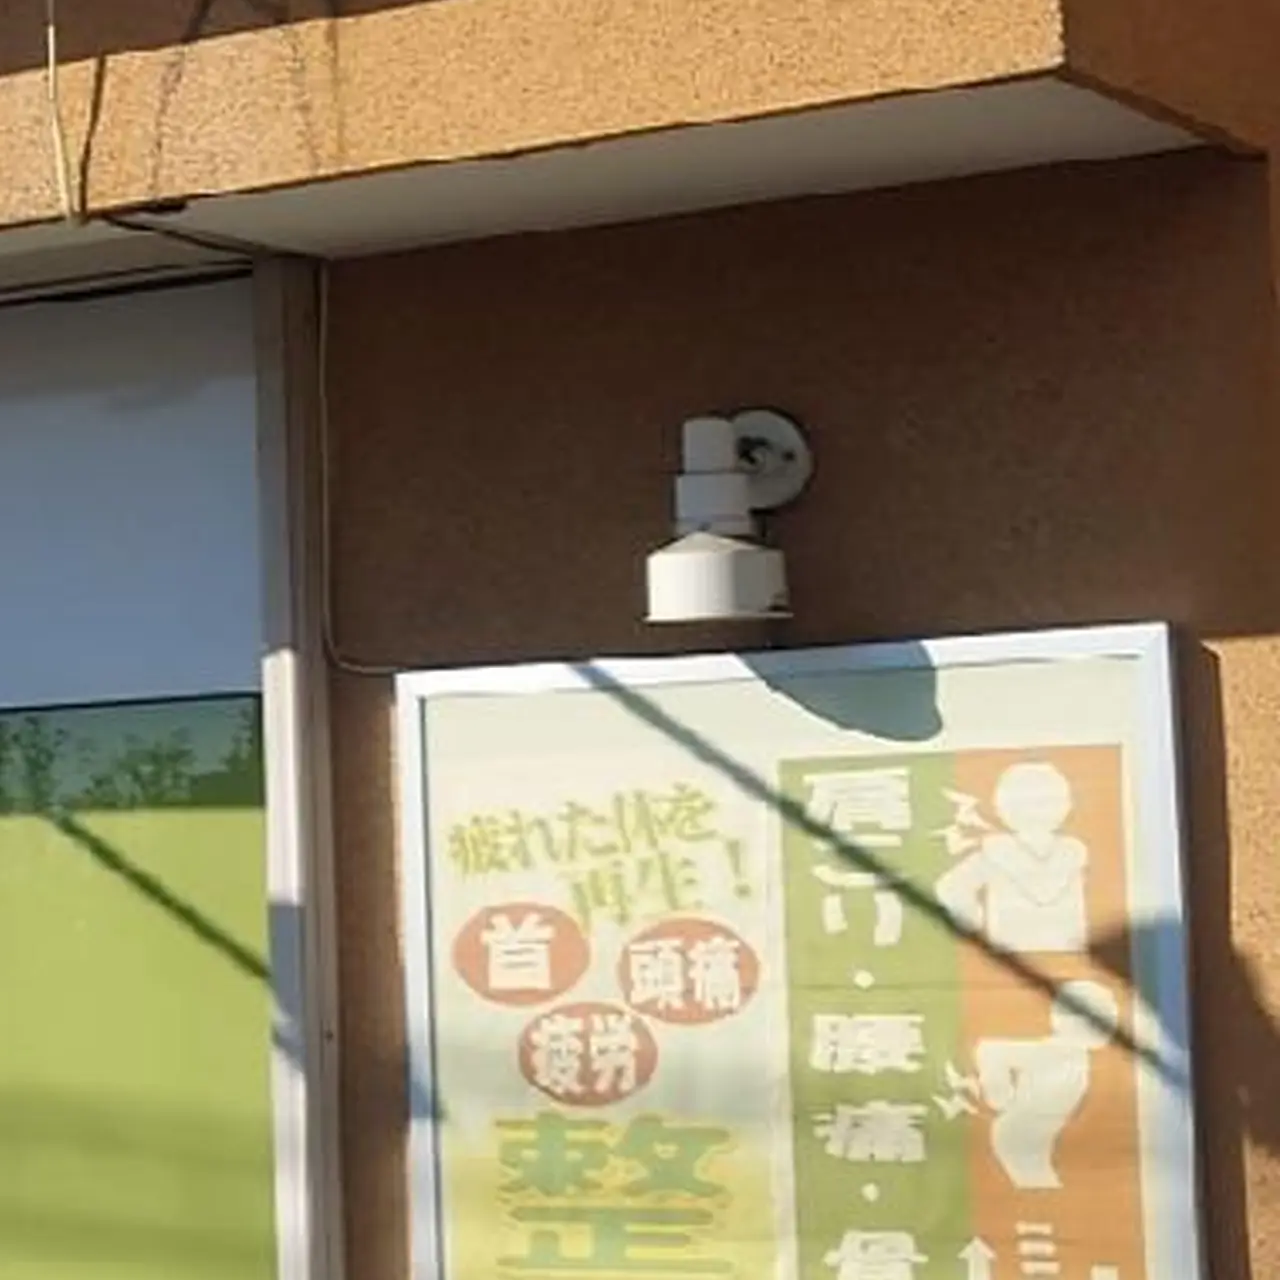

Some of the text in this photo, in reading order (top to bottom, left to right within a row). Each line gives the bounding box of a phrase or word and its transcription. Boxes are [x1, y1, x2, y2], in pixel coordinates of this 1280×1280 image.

[480, 913, 555, 990] 首
[629, 936, 741, 1016] 頭痛
[530, 1014, 640, 1094] 疲労
